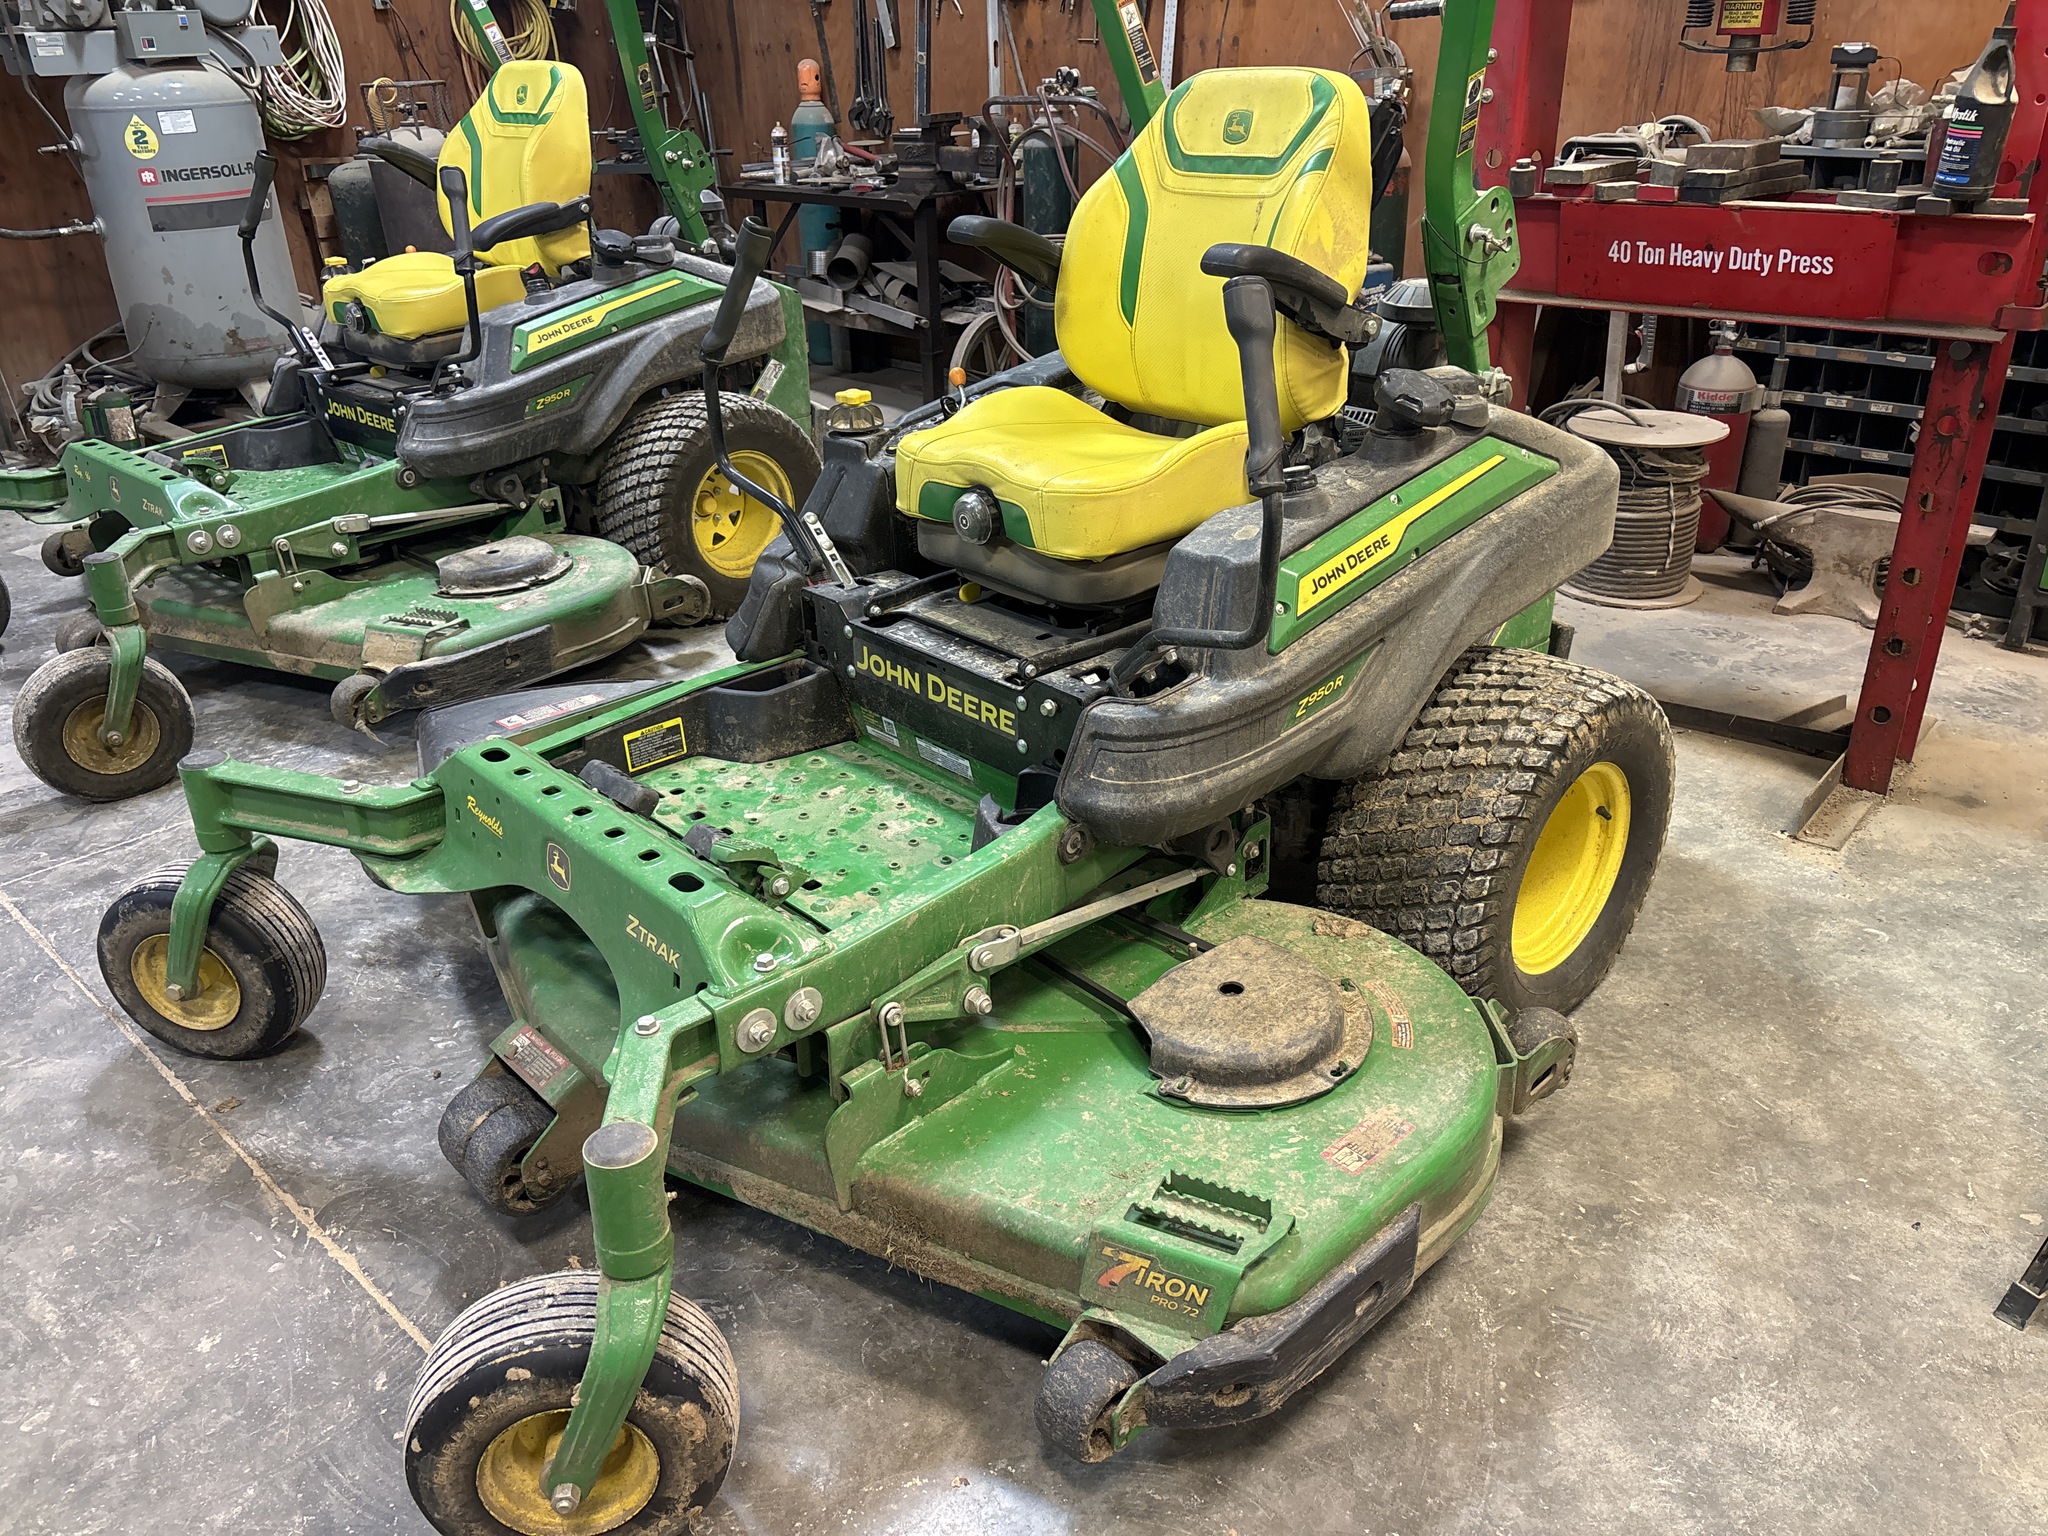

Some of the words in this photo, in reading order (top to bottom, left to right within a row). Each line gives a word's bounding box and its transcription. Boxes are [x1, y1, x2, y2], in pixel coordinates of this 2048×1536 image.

[132, 130, 149, 145] 2
[161, 162, 255, 183] INGERSOLL-R
[1608, 240, 1631, 263] 40
[1636, 241, 1665, 265] Ton
[1669, 243, 1724, 273] Heavy
[1728, 246, 1773, 276] Duty
[1777, 248, 1834, 275] Press
[537, 329, 563, 343] JOHN
[562, 315, 595, 333] DEERE
[536, 388, 571, 410] Z950R
[1697, 391, 1734, 402] Kidde
[327, 398, 356, 421] JOHN
[356, 406, 397, 433] DEERE
[142, 498, 164, 517] ZTRAK
[1311, 563, 1346, 595] JOHN
[1345, 534, 1391, 570] DEERE
[856, 646, 920, 694] JOHN
[927, 673, 1016, 736] DEERE
[1295, 674, 1344, 718] Z950R
[644, 724, 664, 733] CAUTION
[467, 795, 503, 836] Reynolds
[626, 913, 680, 970] ZTRAK
[1150, 1294, 1178, 1311] PRO
[1182, 1305, 1200, 1318] 72
